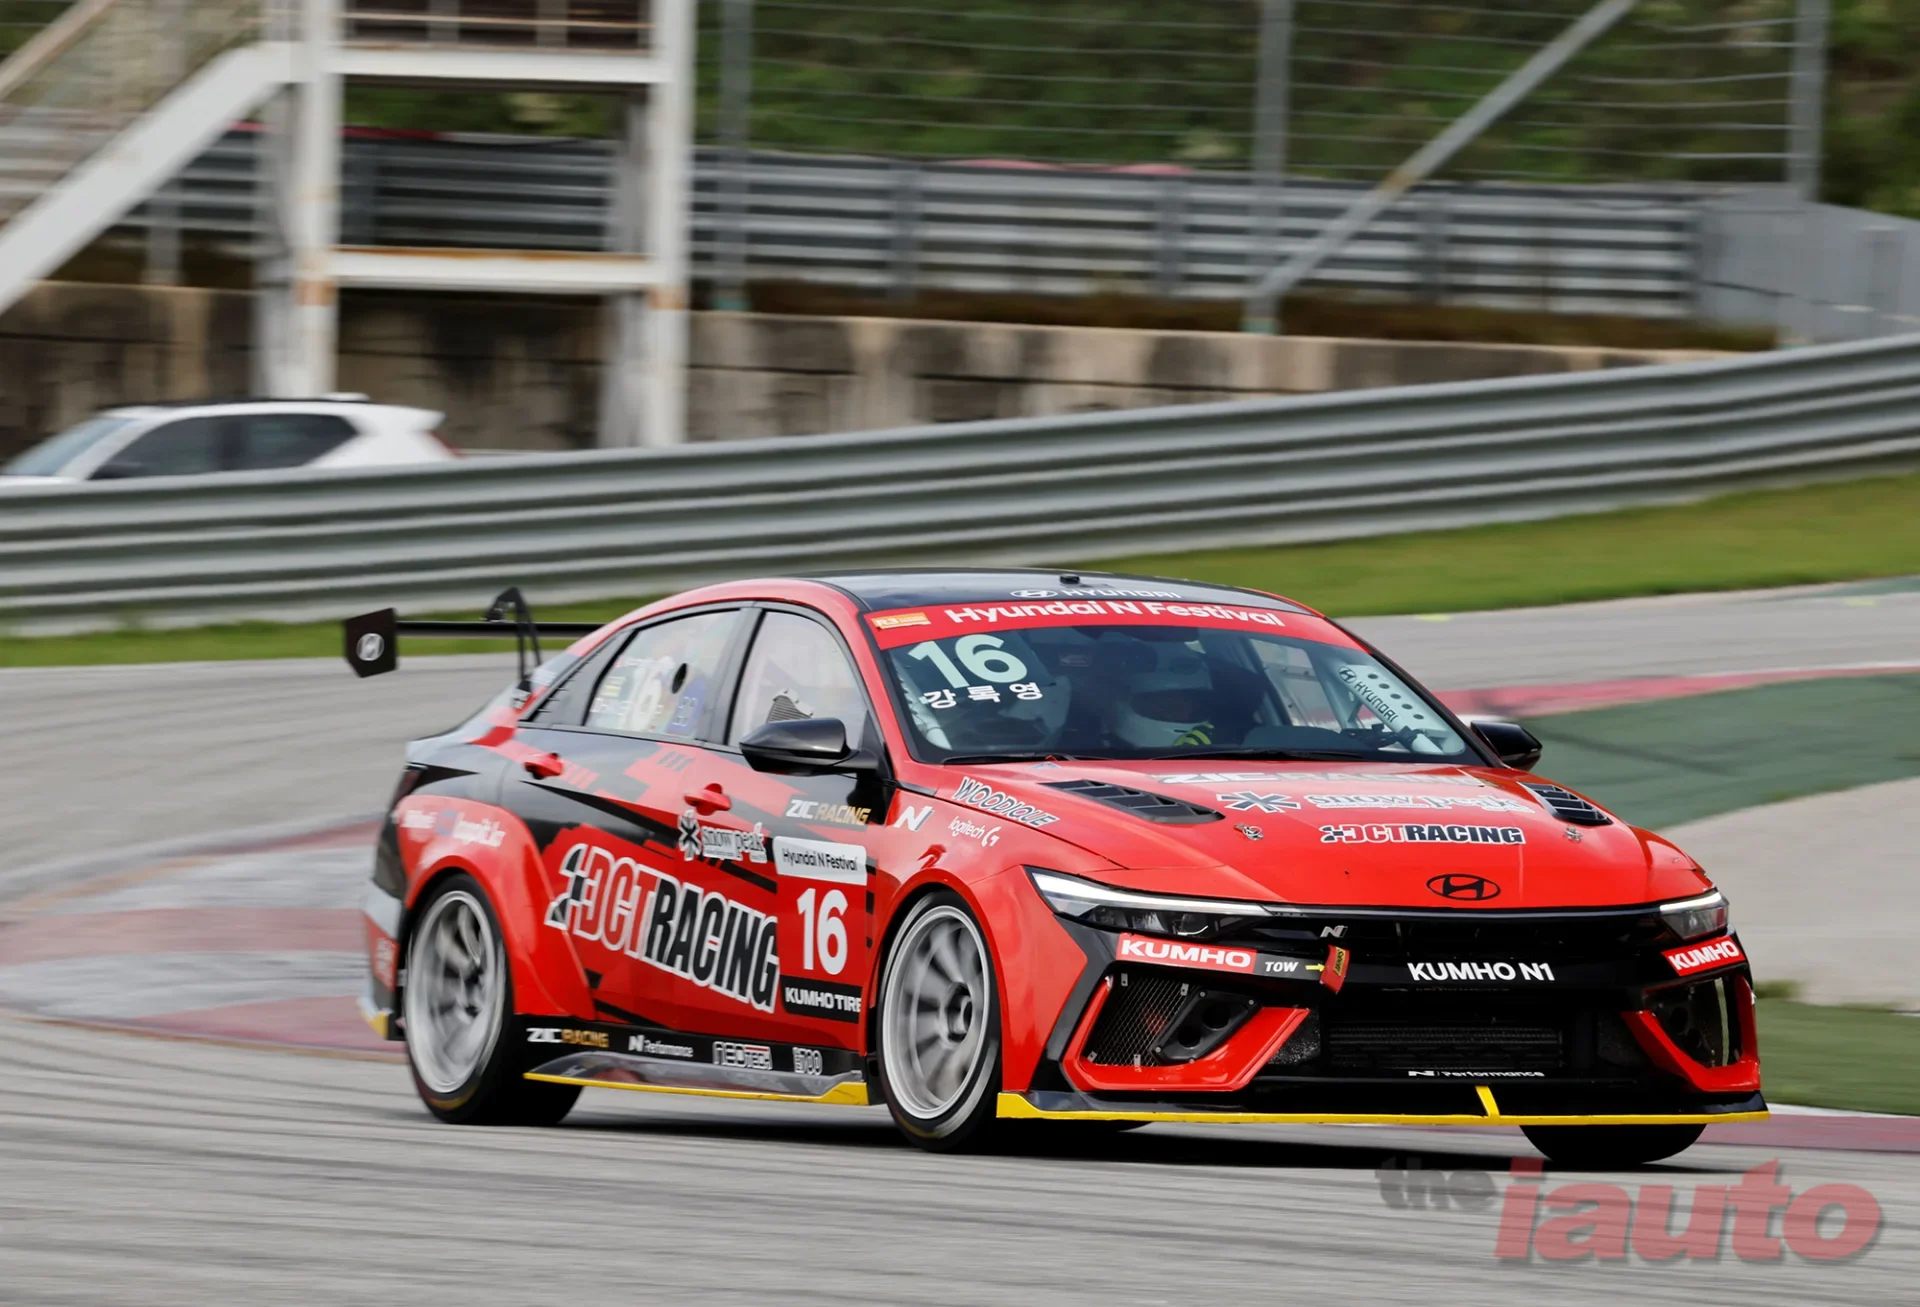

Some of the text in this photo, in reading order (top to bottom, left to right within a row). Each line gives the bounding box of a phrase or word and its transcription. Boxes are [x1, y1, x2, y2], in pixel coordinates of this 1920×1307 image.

[1061, 589, 1182, 599] HYUNDAI
[945, 601, 1286, 627] Hyundai N Festival
[908, 634, 1028, 689] 16
[1354, 680, 1398, 723] HYUNDAI
[1152, 772, 1278, 784] ZIC
[786, 799, 872, 825] ZIC RACING
[951, 776, 1060, 828] WOODIQUE
[703, 823, 765, 858] snow peak
[948, 816, 985, 839] logitech
[783, 847, 817, 867] Hyundai
[817, 855, 826, 868] N
[825, 856, 858, 872] Festival
[796, 888, 849, 976] 16
[1121, 939, 1299, 972] KUMHO TOW
[1668, 940, 1740, 970] KUMHO
[1407, 962, 1555, 981] KUMHO N1
[784, 986, 861, 1013] KUMHO TIRE
[526, 1028, 609, 1048] ZIC RACING
